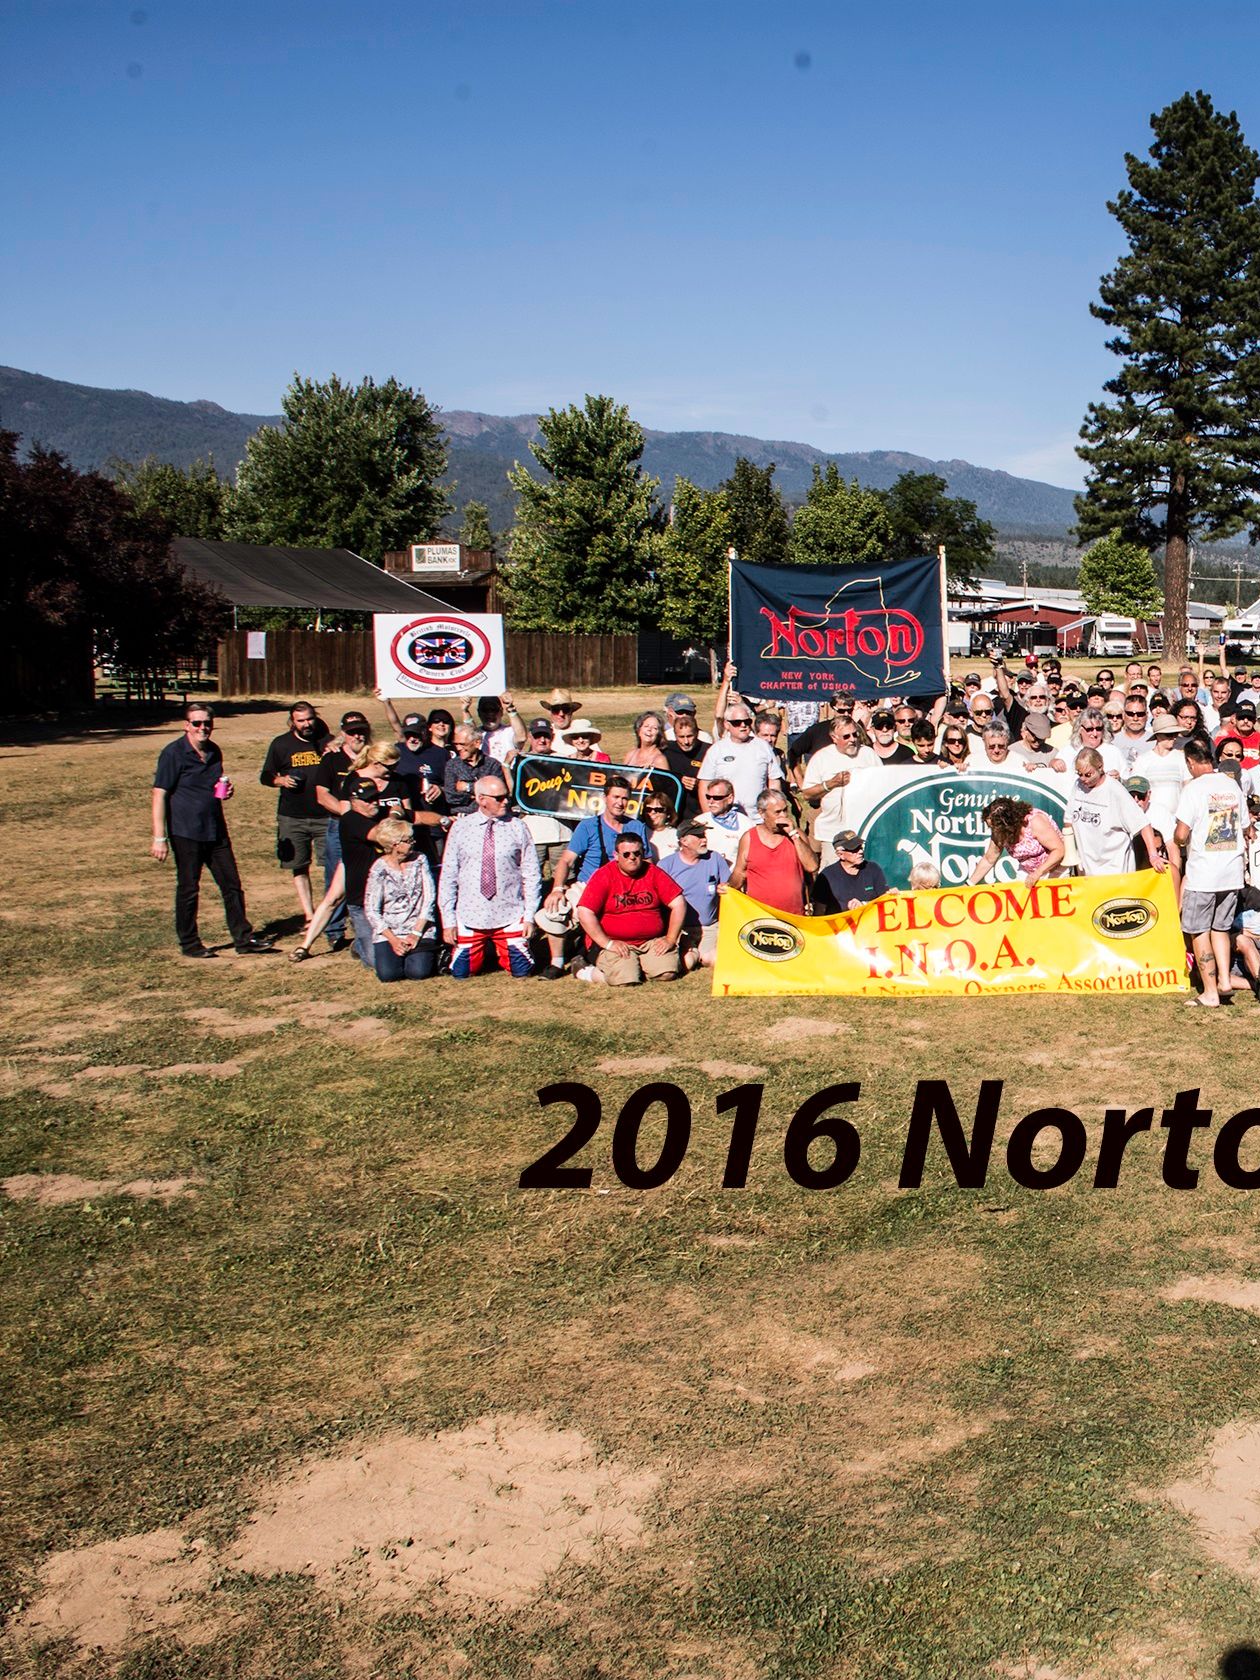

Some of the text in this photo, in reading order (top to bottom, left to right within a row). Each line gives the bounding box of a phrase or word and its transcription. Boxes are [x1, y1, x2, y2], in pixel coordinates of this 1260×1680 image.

[427, 547, 457, 555] PLUMAS
[427, 556, 448, 564] BANK
[760, 604, 924, 667] Norton
[760, 681, 803, 690] CHAPTER
[807, 682, 818, 690] of
[781, 671, 835, 681] NEW YORK
[525, 767, 572, 797] Doug's
[613, 890, 654, 909] Norton
[824, 883, 1076, 937] WELCOME
[1102, 908, 1148, 928] Norton
[750, 930, 795, 951] Norton
[865, 934, 1036, 980] I.N.O.A.
[1056, 962, 1179, 993] Association
